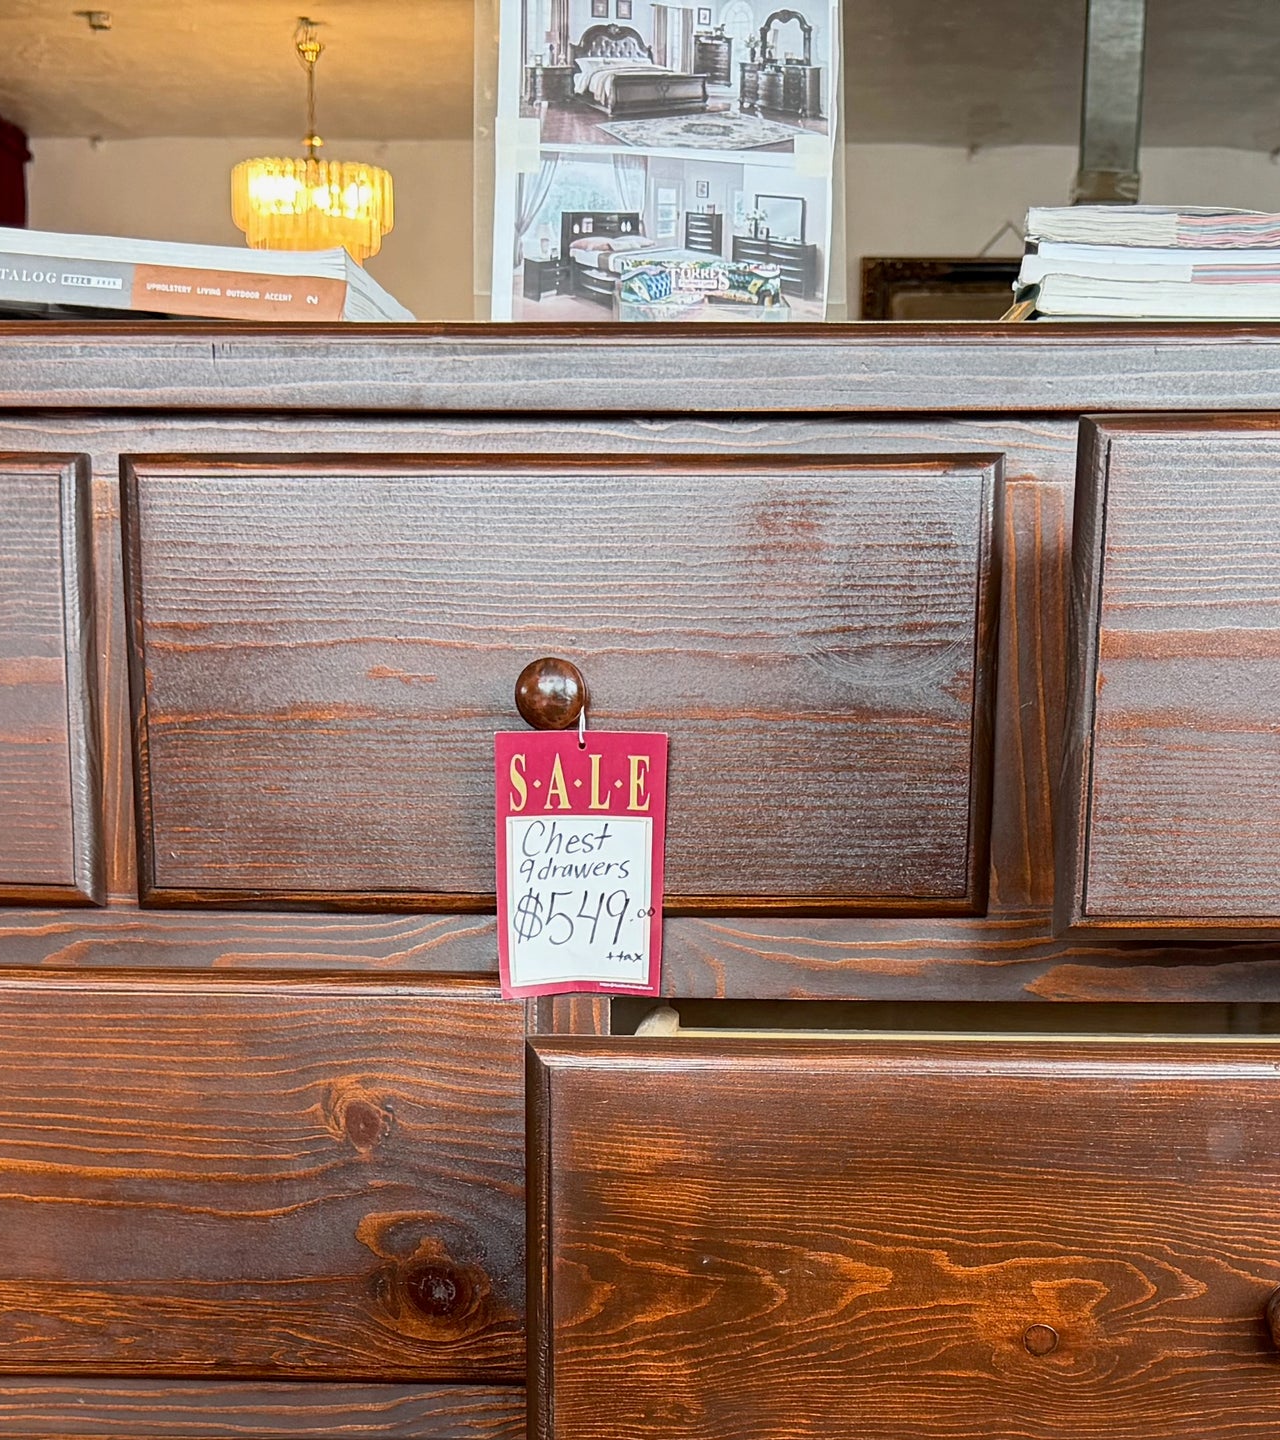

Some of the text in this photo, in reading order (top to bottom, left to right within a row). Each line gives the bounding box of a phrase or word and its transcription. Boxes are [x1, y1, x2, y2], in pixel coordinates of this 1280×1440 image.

[146, 283, 192, 294] UPHOLSTERY
[197, 286, 221, 297] LIVING
[226, 289, 260, 300] OUTDOOR
[264, 292, 293, 302] ACCENT
[522, 820, 612, 857] Chest
